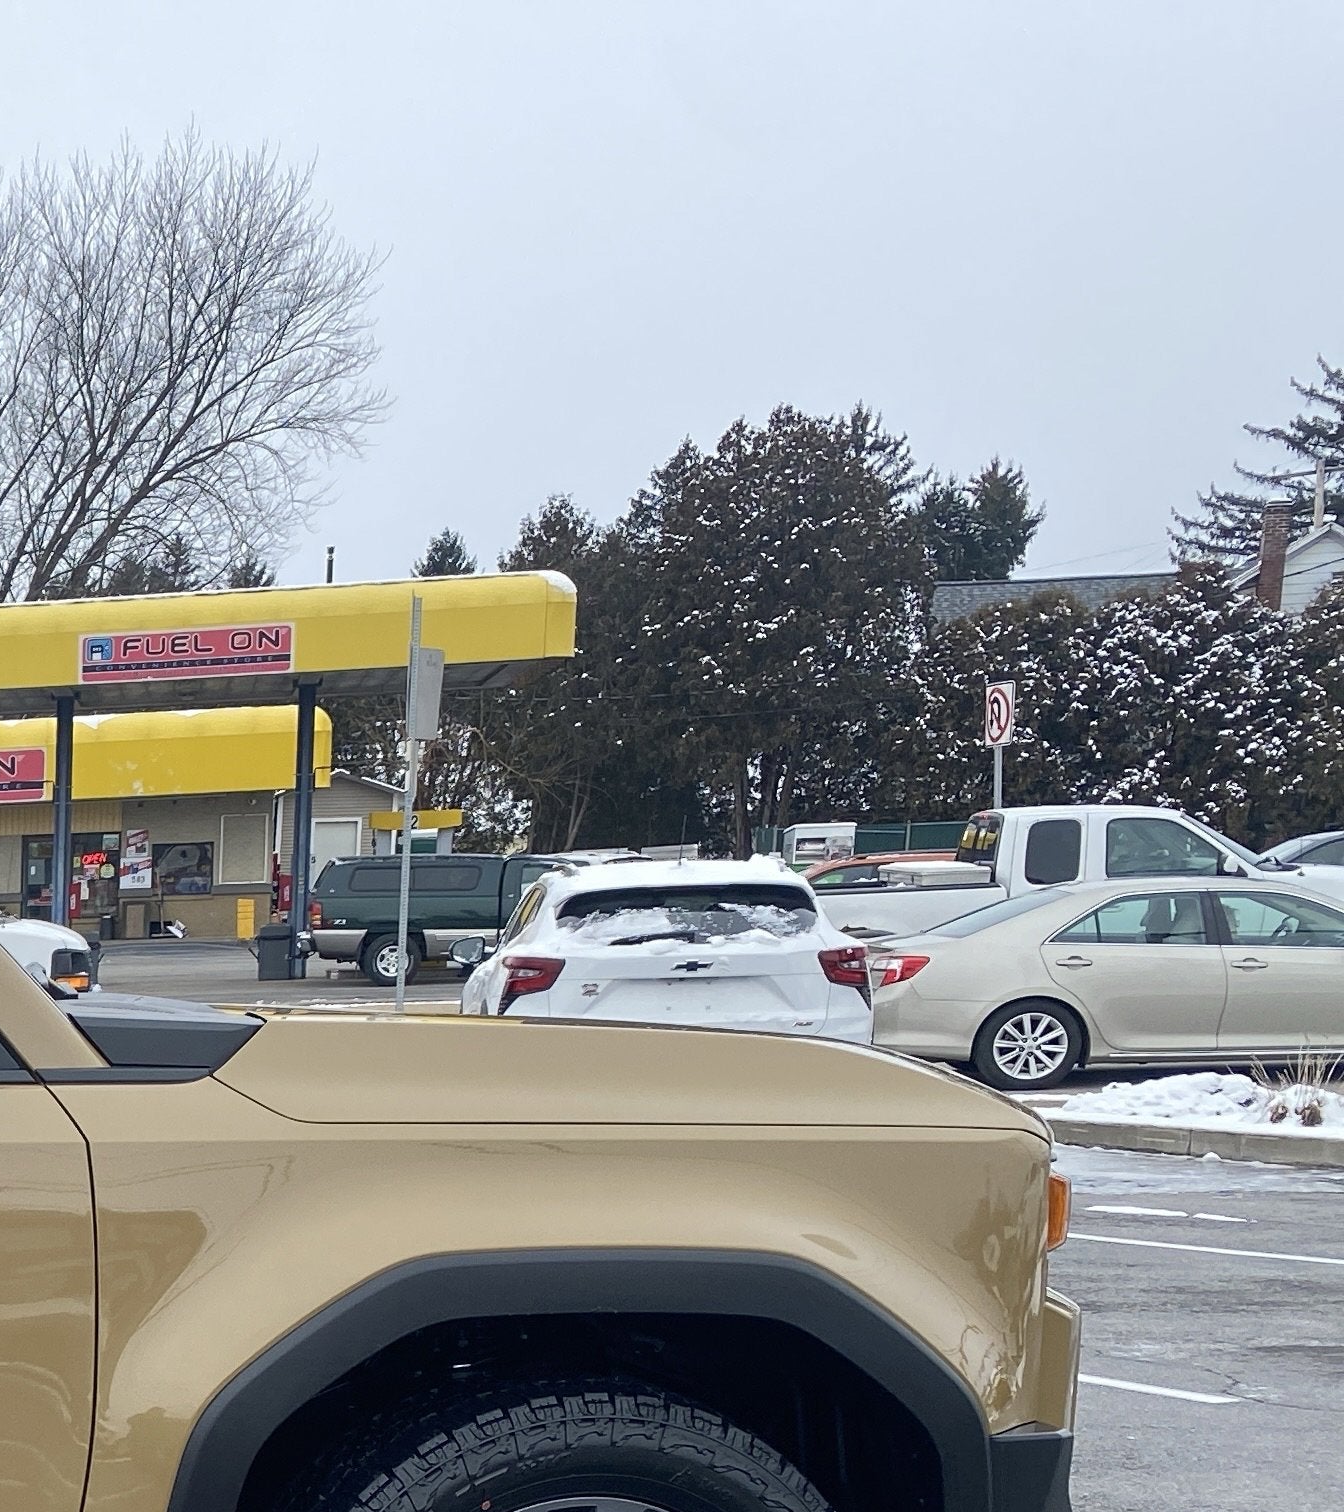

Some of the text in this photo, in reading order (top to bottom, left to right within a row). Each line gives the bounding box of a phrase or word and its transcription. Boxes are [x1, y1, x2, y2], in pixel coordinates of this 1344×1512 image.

[121, 628, 281, 658] FUEL ON
[95, 655, 273, 671] CONVENIENCE STORE
[411, 815, 419, 829] 2
[81, 852, 107, 865] OPEN
